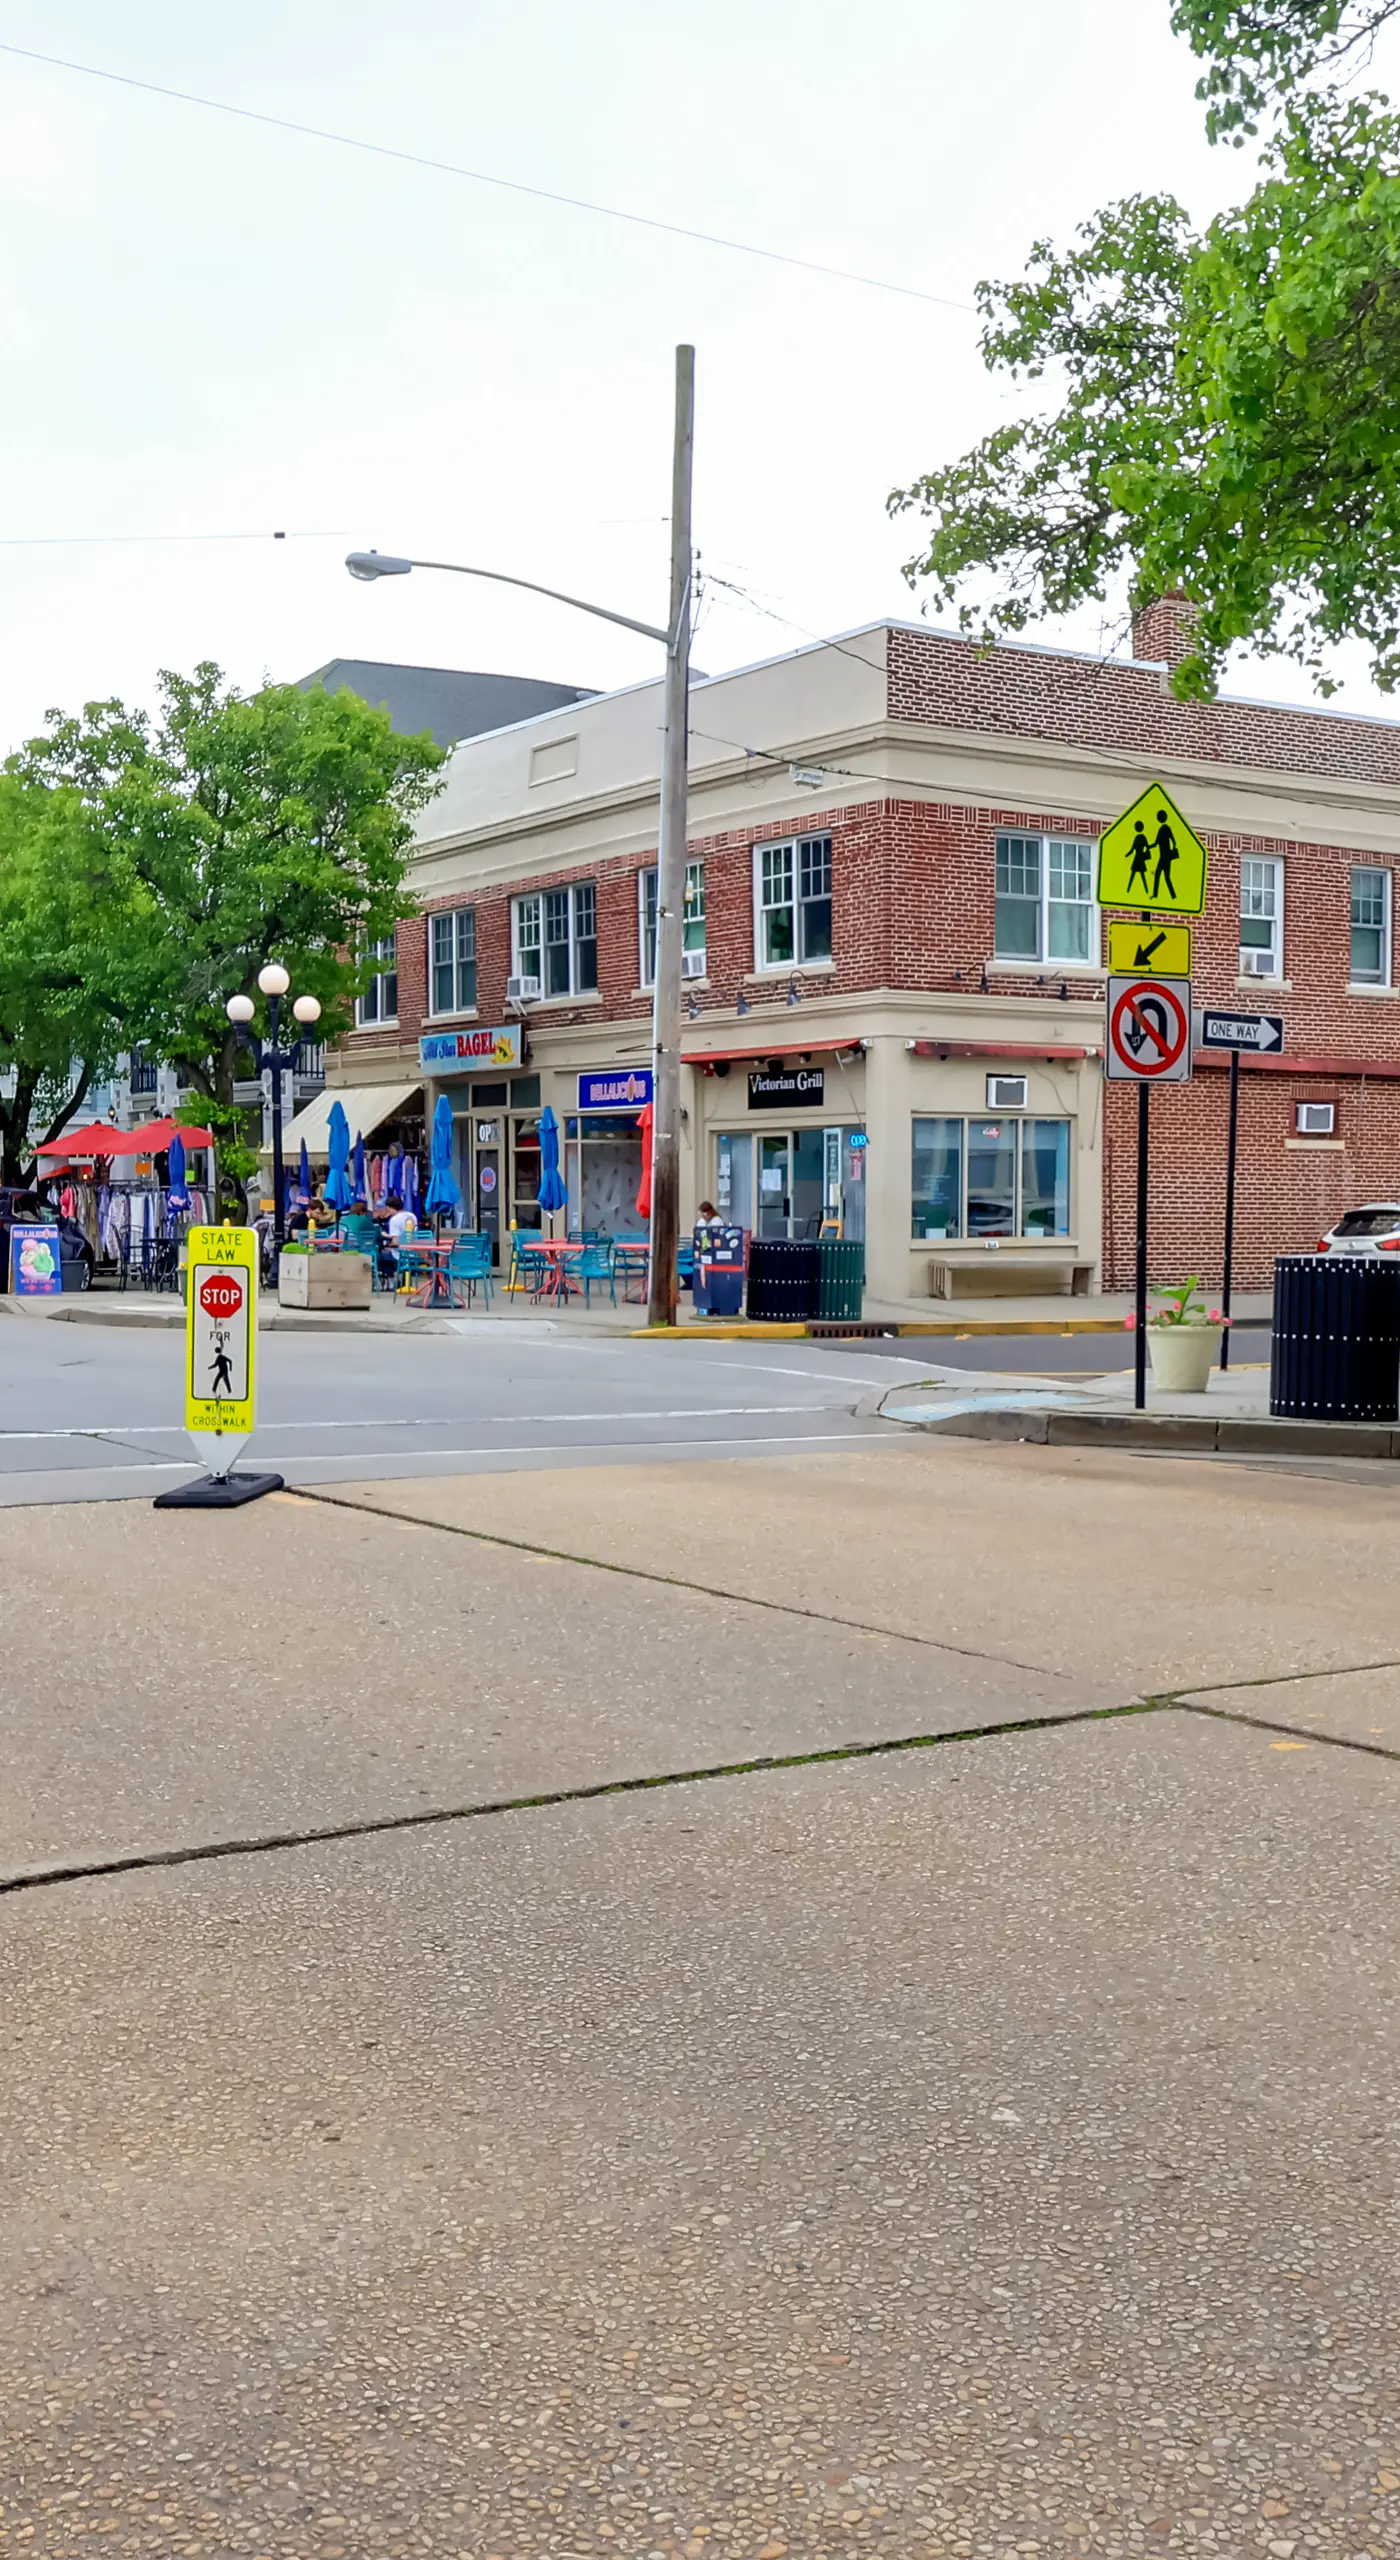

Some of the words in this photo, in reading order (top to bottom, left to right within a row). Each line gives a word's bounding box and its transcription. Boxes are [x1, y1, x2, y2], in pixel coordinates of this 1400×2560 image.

[1211, 1022, 1232, 1037] ONE
[1236, 1024, 1259, 1039] WAY
[457, 1031, 496, 1057] BAGEL
[749, 1074, 795, 1093] Victorian
[797, 1071, 823, 1090] Grill
[201, 1232, 242, 1246] STATE
[207, 1249, 235, 1261] LAW
[202, 1288, 240, 1305] STOP
[210, 1331, 231, 1341] FOR
[192, 1416, 247, 1427] CROSSWALK
